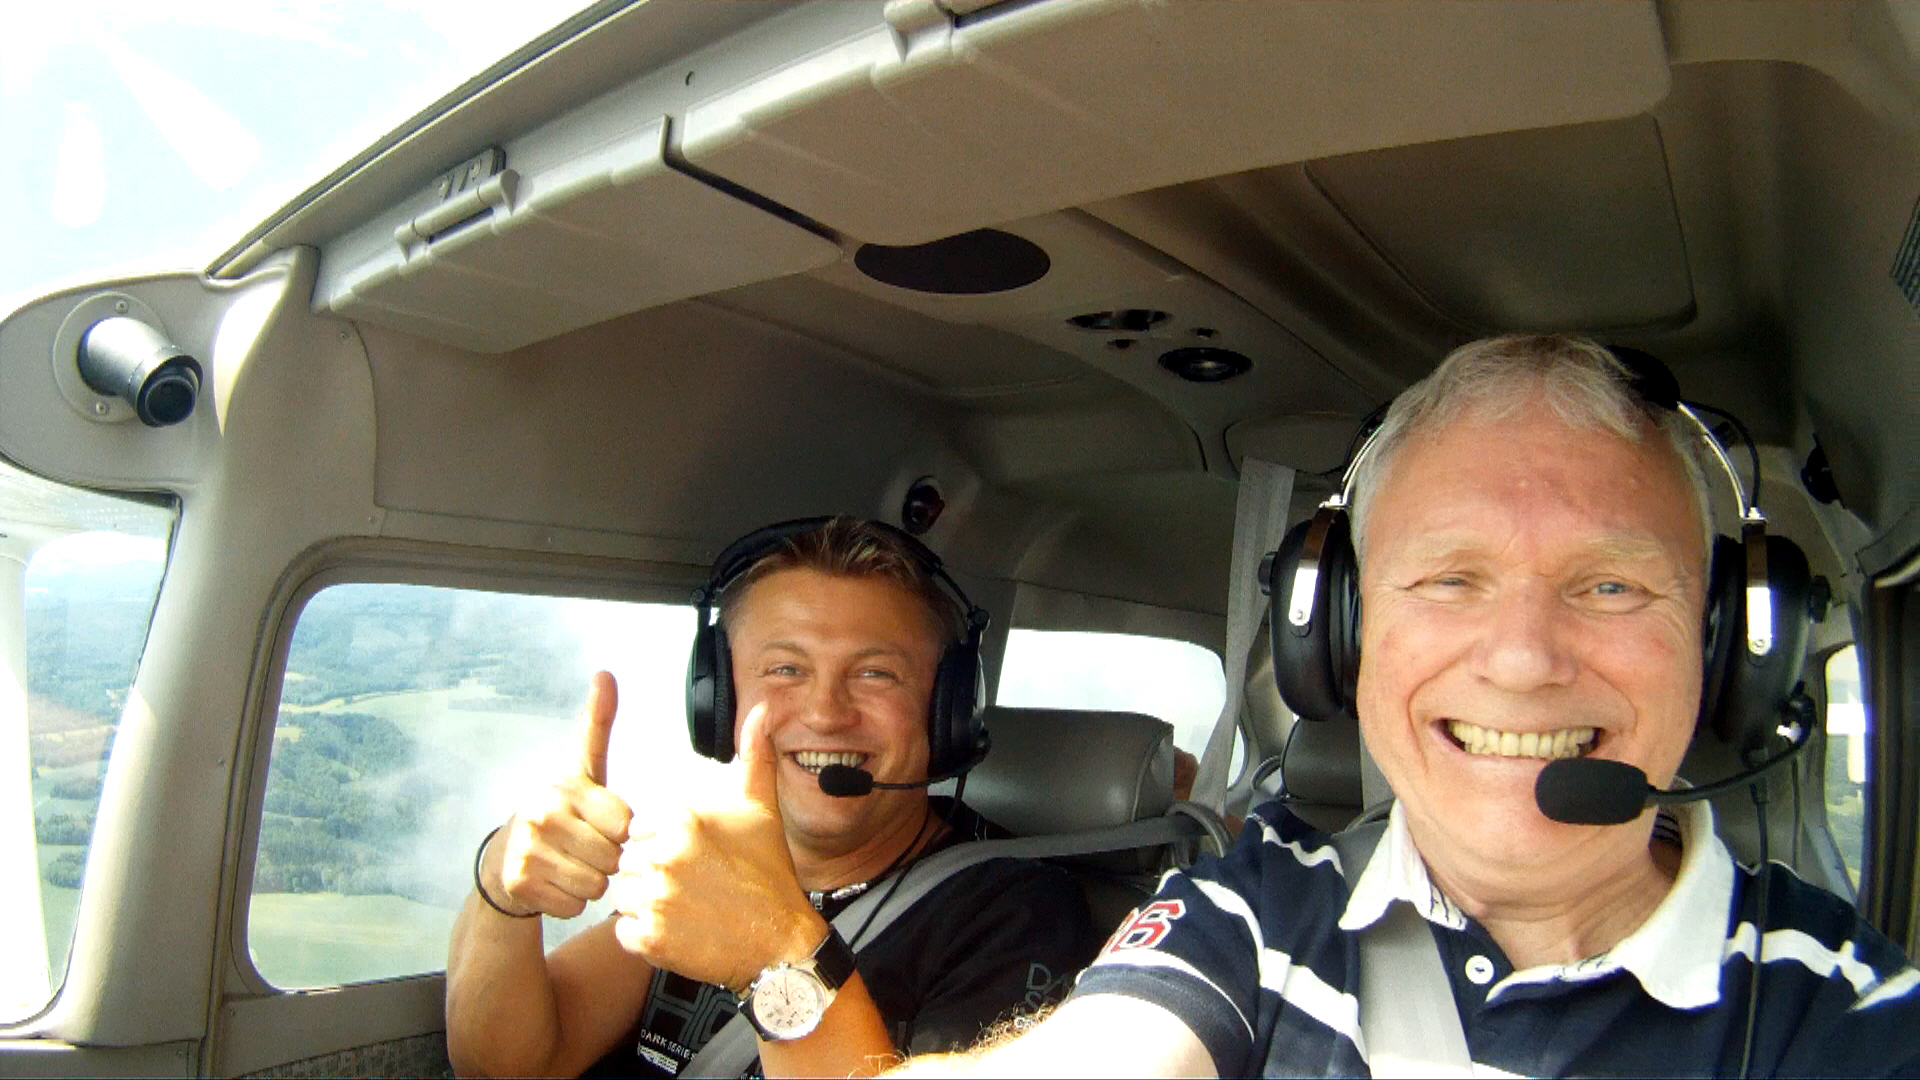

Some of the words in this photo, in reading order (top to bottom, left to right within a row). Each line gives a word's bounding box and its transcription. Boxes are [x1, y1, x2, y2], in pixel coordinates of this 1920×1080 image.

[1096, 899, 1187, 961] 6
[640, 1028, 668, 1048] DARK
[667, 1040, 697, 1062] SERIES
